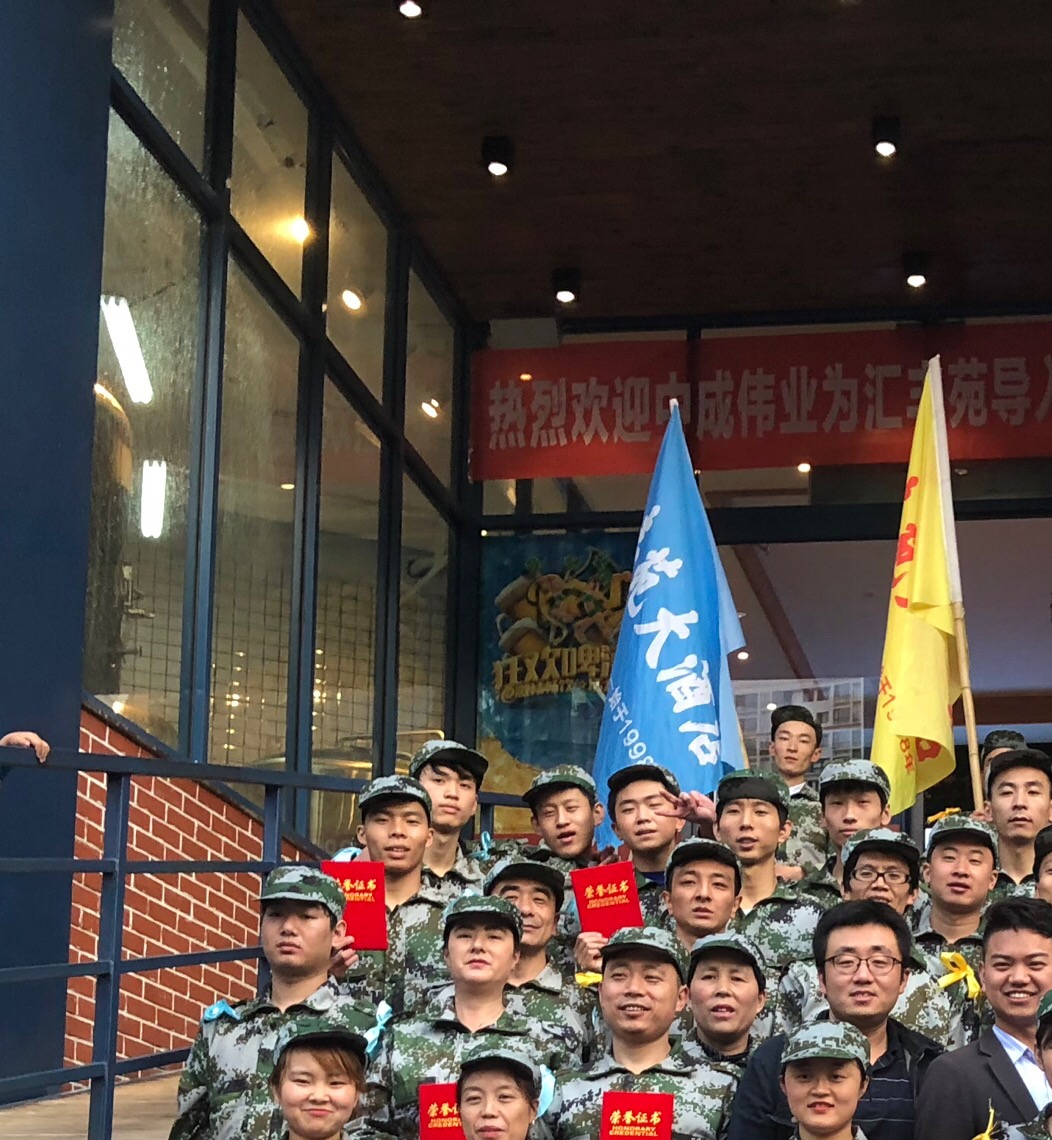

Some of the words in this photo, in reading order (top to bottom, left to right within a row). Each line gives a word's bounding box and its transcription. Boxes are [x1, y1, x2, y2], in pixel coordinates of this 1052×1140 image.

[337, 877, 377, 891] 誉证书
[584, 880, 630, 899] 荣誉证书
[609, 1109, 662, 1125] 荣誉证书
[609, 1129, 659, 1137] CREDENTIAL
